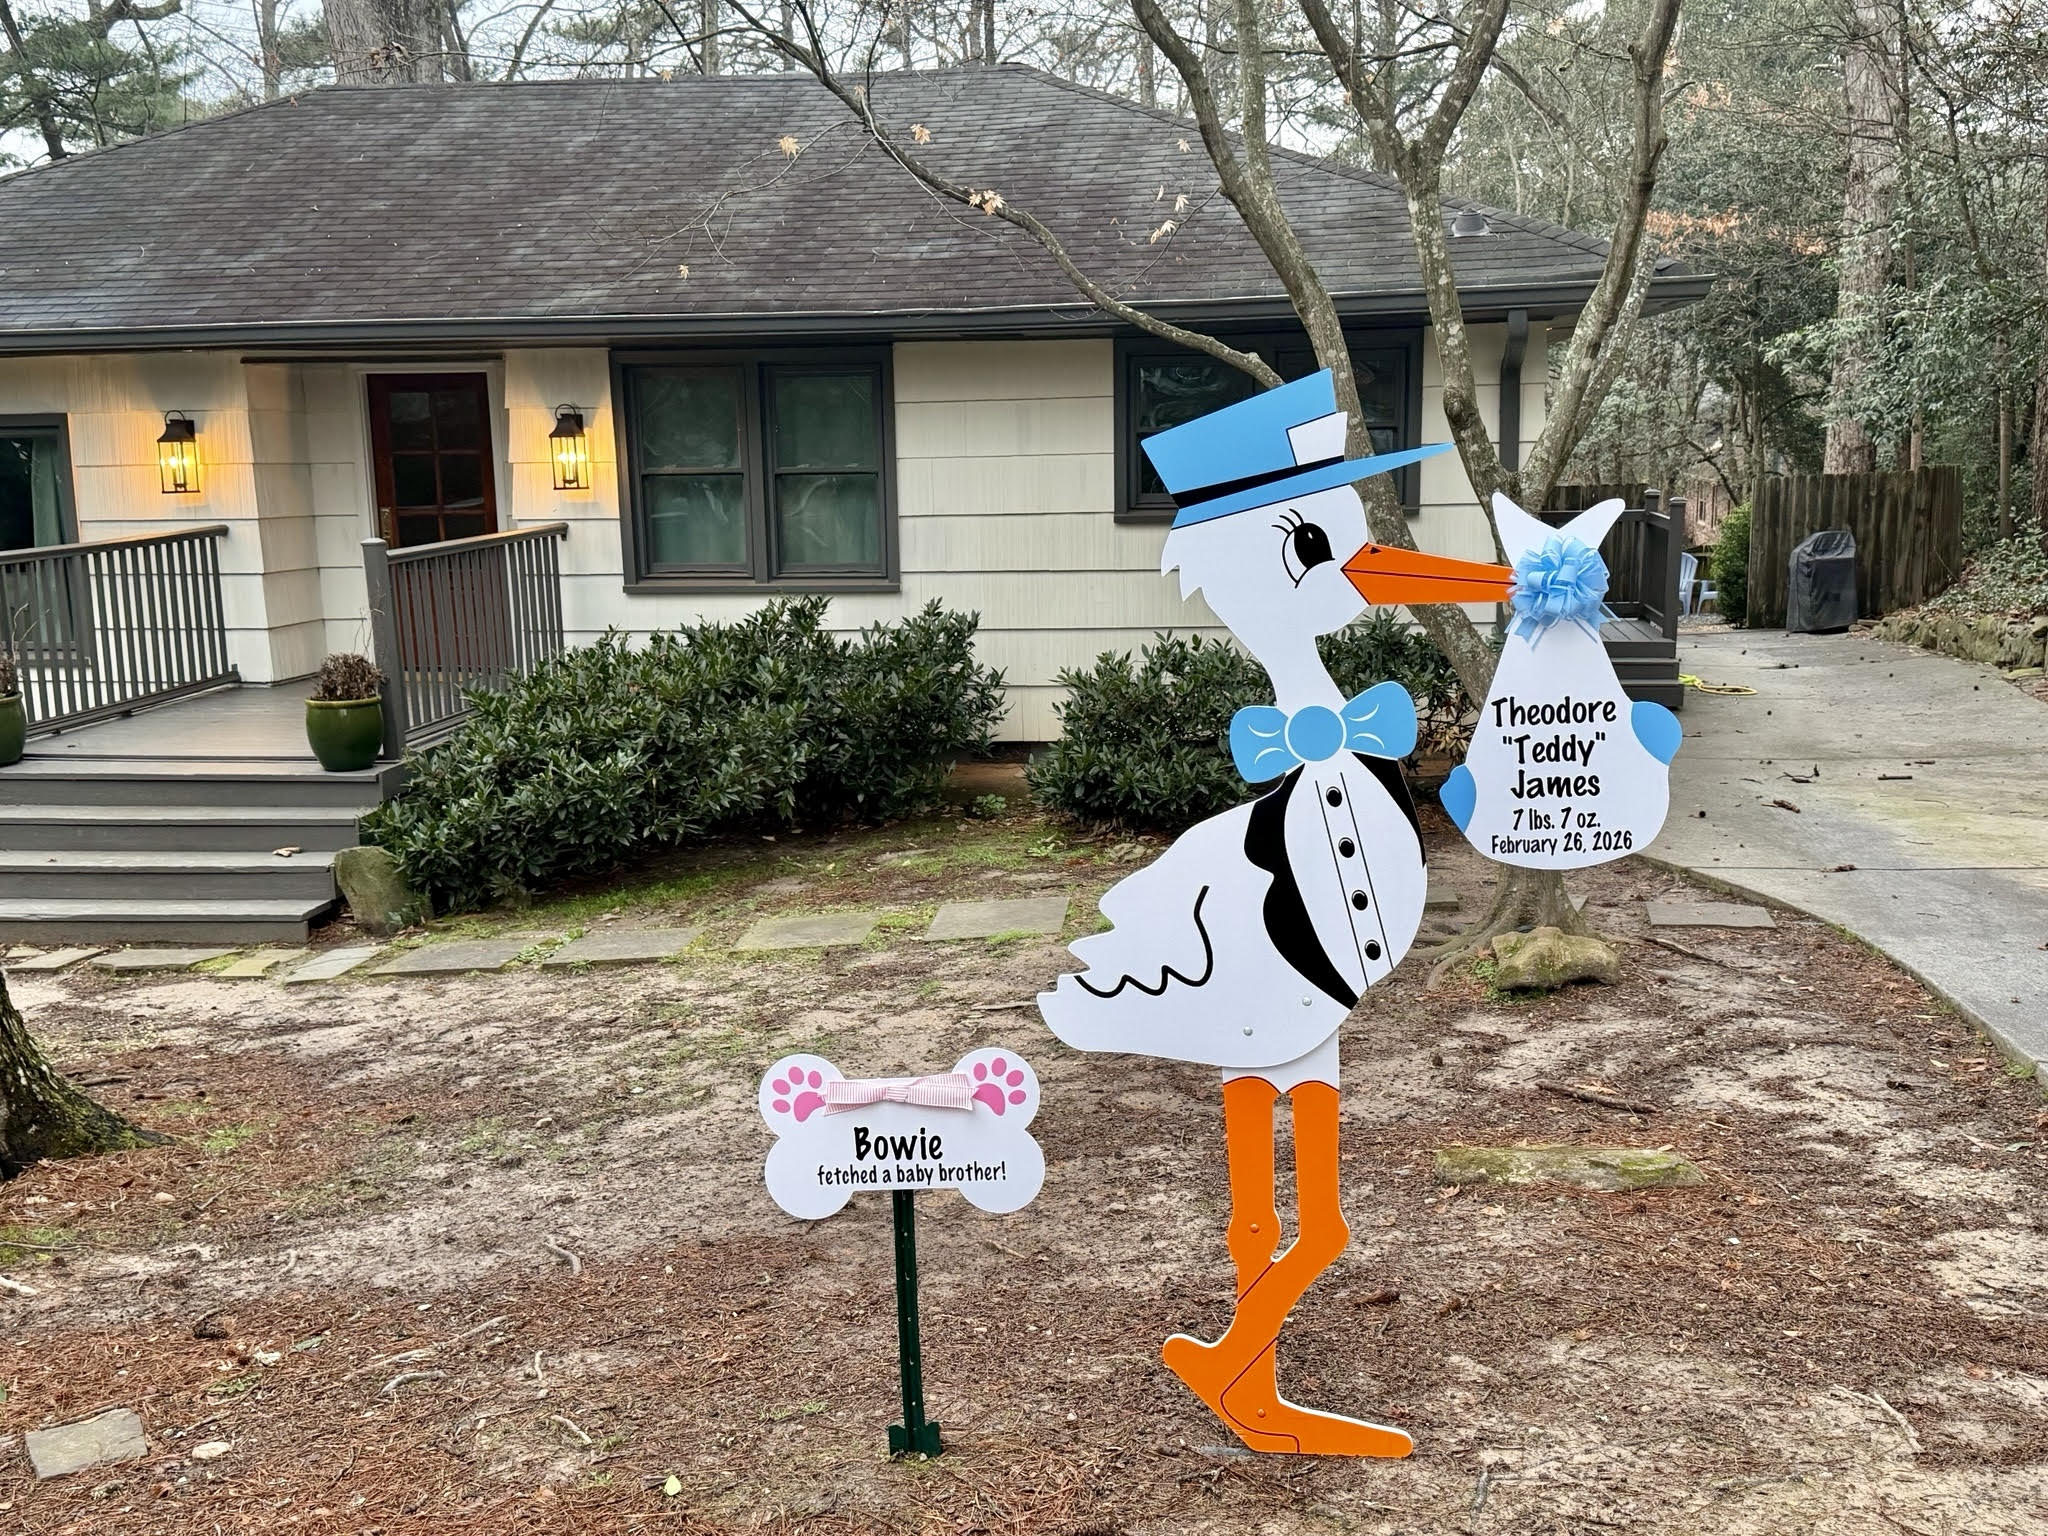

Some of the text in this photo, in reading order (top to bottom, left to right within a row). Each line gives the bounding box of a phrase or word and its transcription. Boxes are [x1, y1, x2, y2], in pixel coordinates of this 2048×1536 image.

[1490, 695, 1617, 728] Theodore
[1502, 731, 1606, 768] "Teddy"
[1510, 768, 1601, 800] James
[1512, 806, 1601, 832] 7 lbs. 7 oz.
[1491, 830, 1633, 857] February 26, 2026
[853, 1126, 944, 1162] Bowie
[817, 1160, 1006, 1186] fetched a baby brother!
